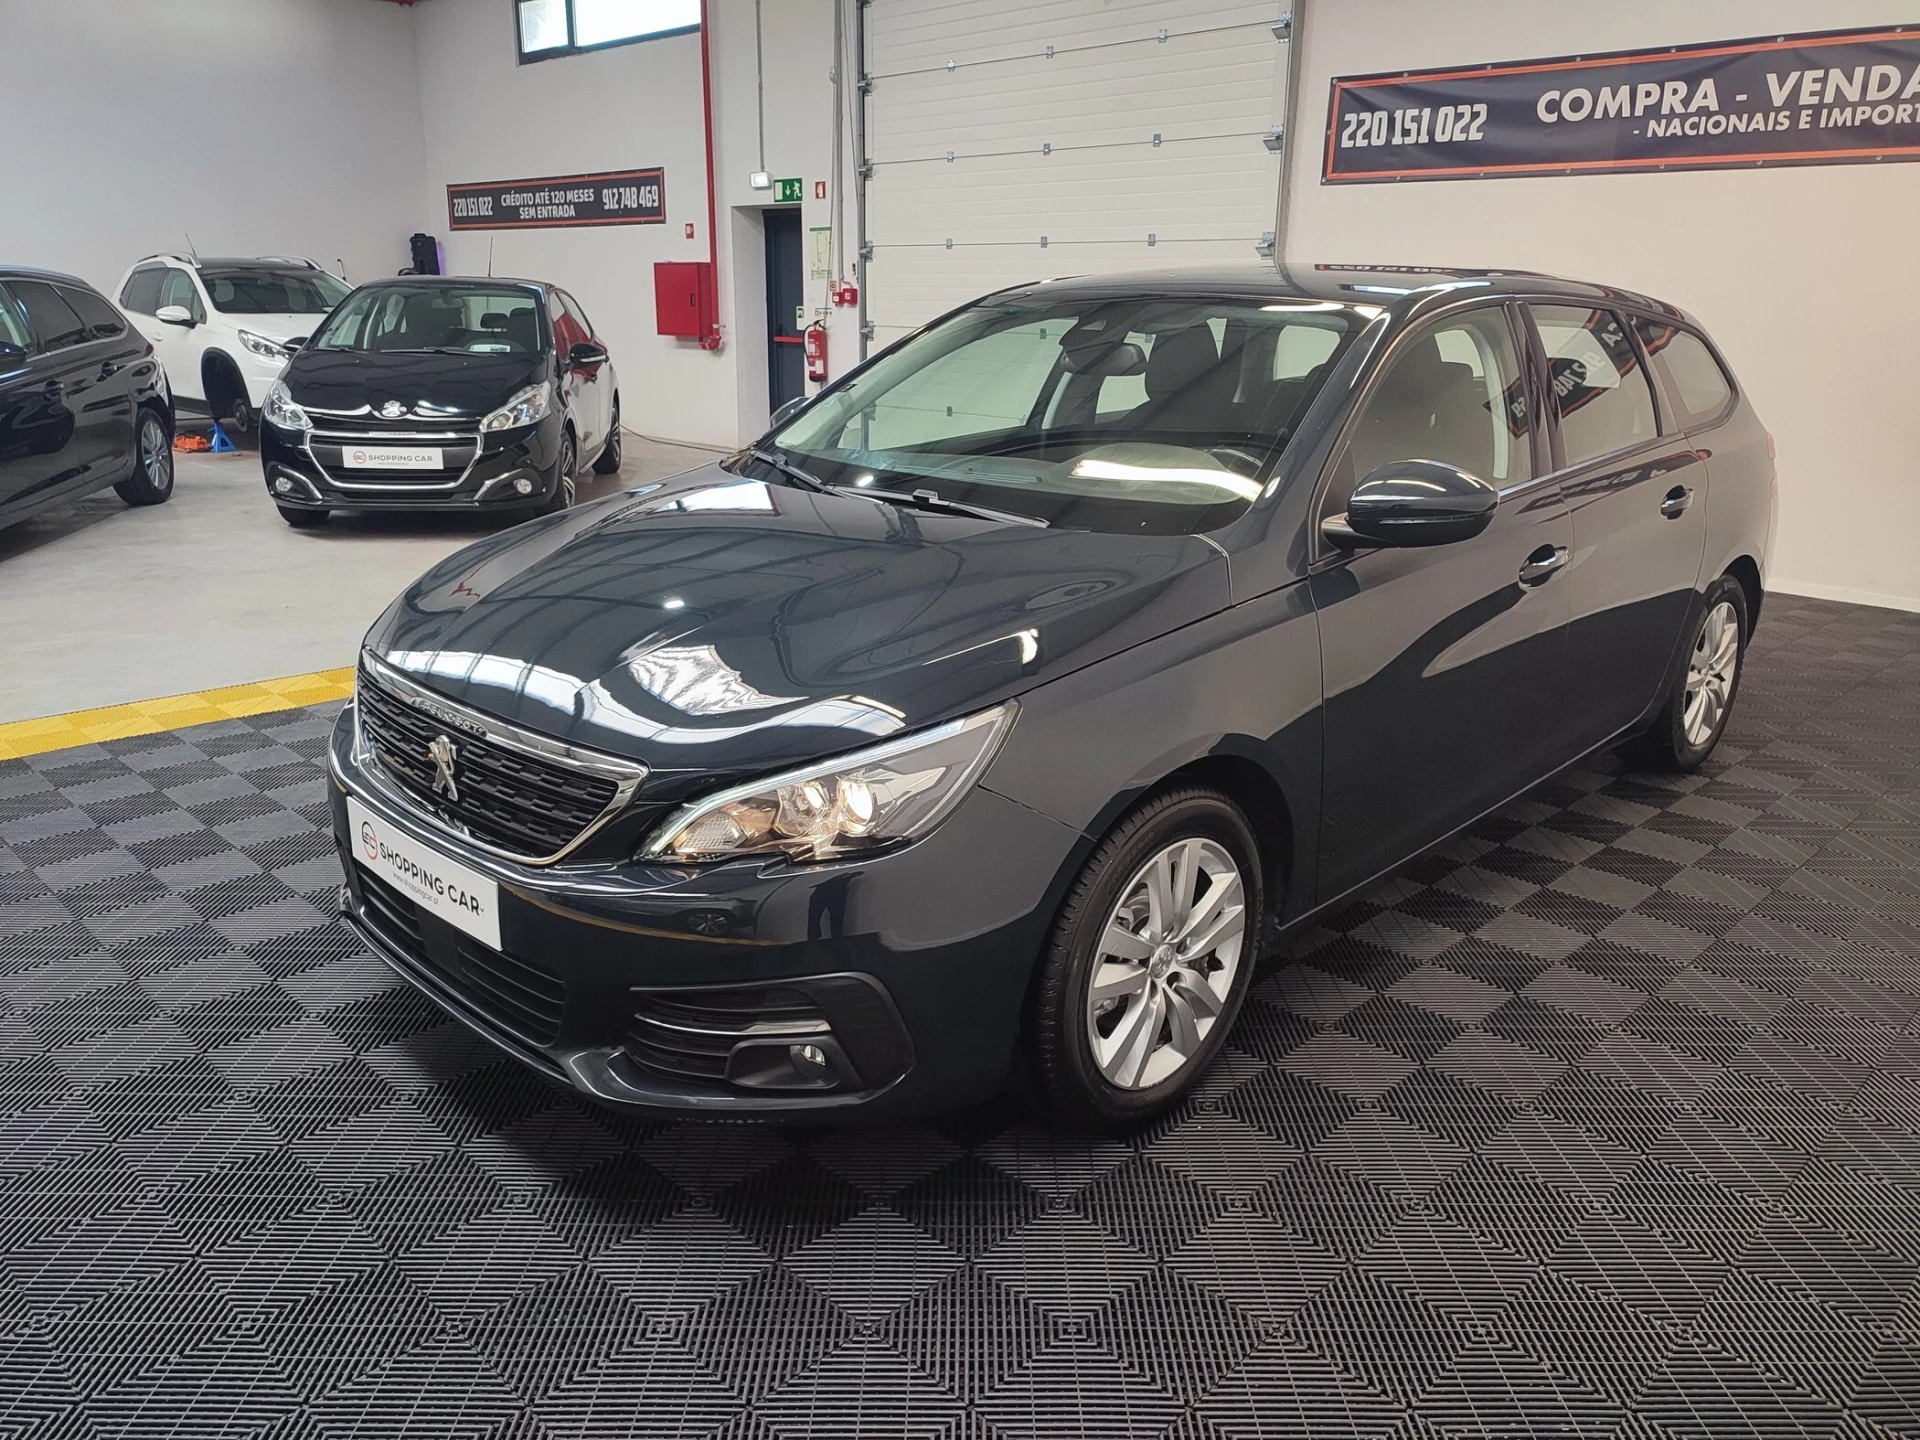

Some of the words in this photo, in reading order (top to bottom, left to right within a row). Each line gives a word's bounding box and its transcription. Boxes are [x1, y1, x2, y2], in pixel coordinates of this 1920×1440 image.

[1536, 78, 1719, 124] COMPRA
[1735, 92, 1748, 102] -
[1766, 63, 1920, 107] VENDA
[1340, 110, 1389, 149] 220
[1391, 107, 1432, 146] 151
[1434, 103, 1488, 143] 022
[1646, 110, 1790, 138] NACIONAIS
[1797, 108, 1813, 129] E
[1819, 102, 1920, 129] IMPOR
[453, 198, 467, 217] 220
[467, 197, 479, 216] 151
[479, 196, 493, 216] 022
[501, 190, 534, 207] CRÉDITO
[534, 188, 550, 205] ATÉ
[550, 191, 566, 204] 120
[566, 188, 594, 203] MESES
[602, 187, 619, 210] 912
[619, 186, 638, 209] 748
[638, 185, 659, 208] 469
[519, 207, 537, 220] SEM
[537, 204, 576, 219] ENTRADA
[368, 454, 413, 462] SHOPPING
[380, 842, 444, 895] SHOPPING
[448, 884, 480, 917] CAR
